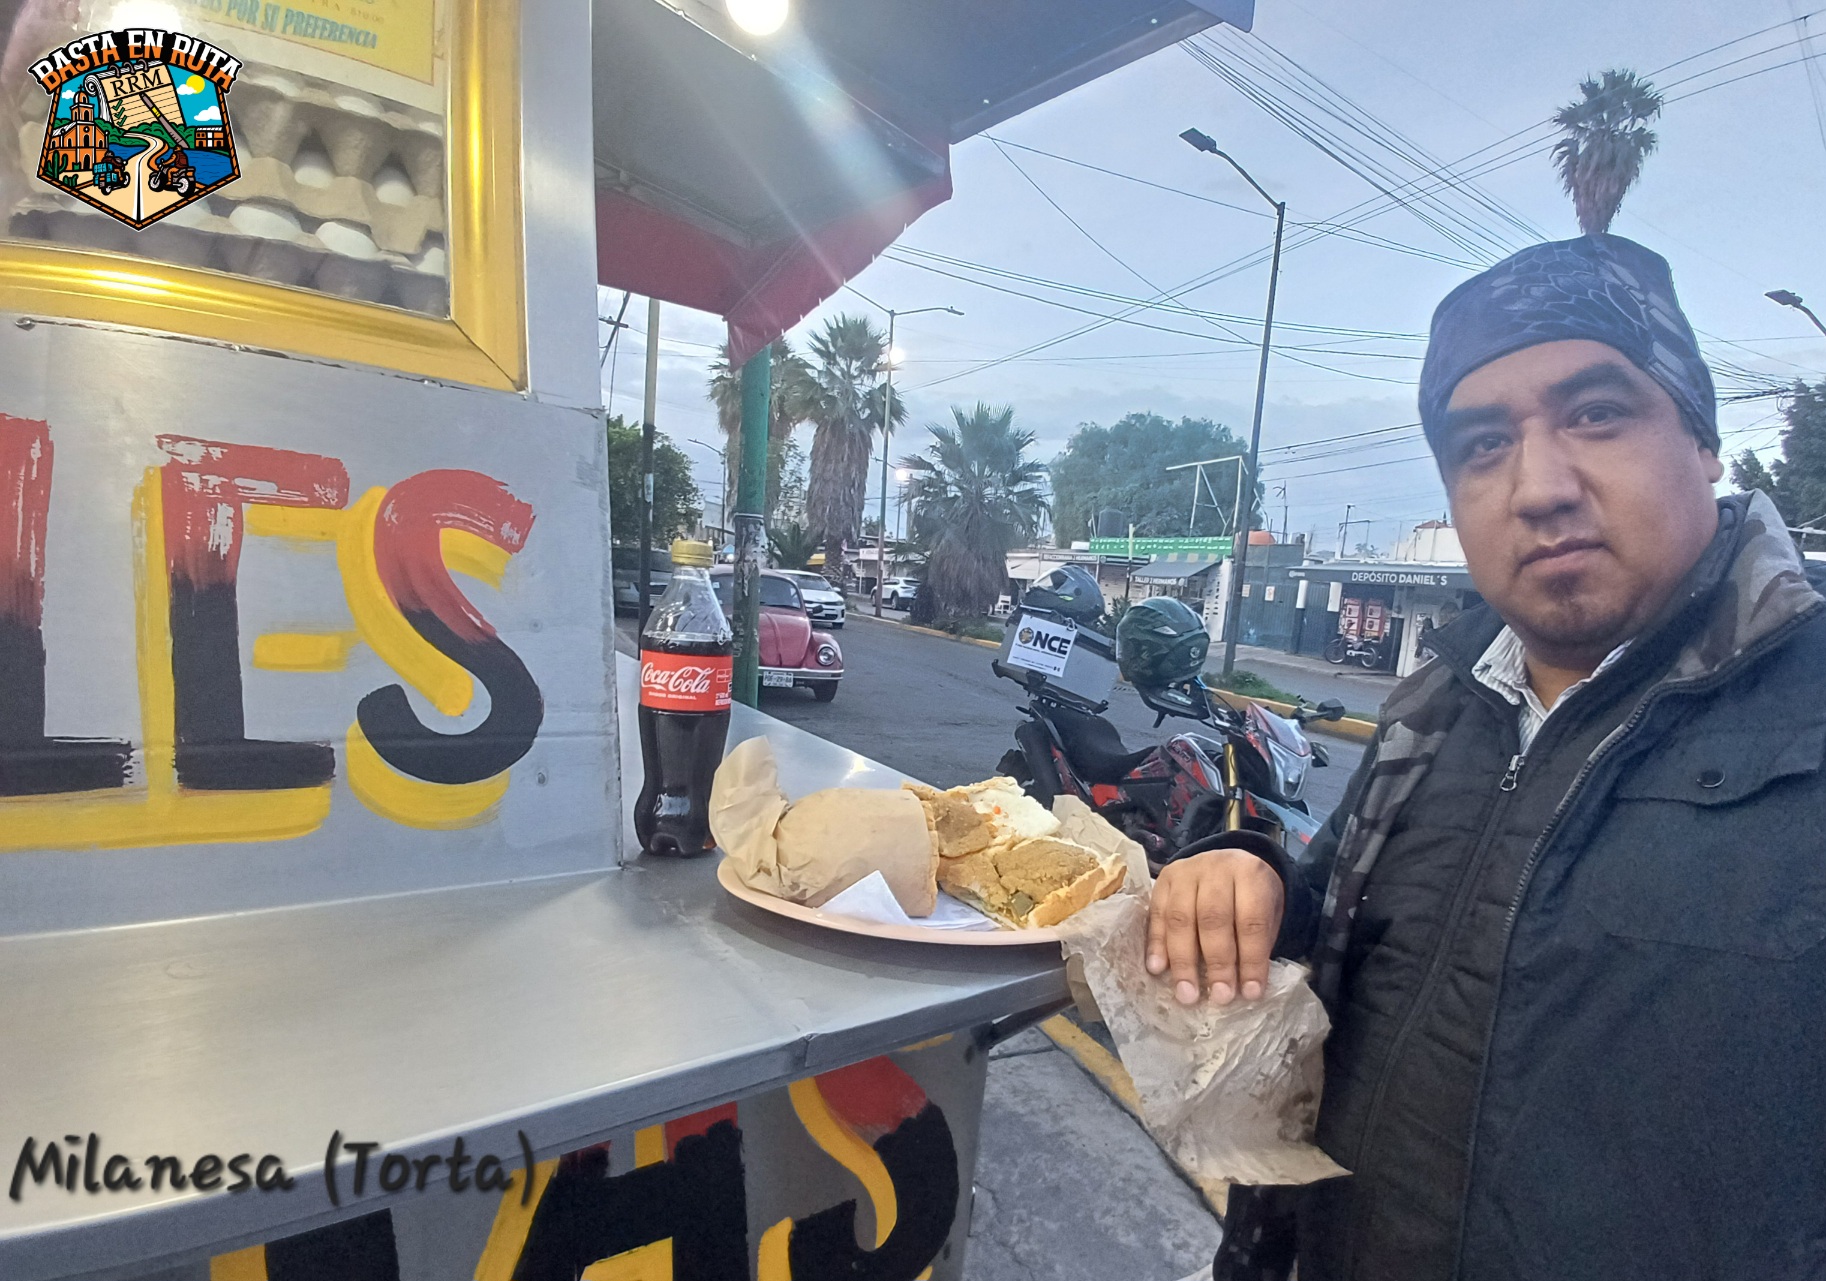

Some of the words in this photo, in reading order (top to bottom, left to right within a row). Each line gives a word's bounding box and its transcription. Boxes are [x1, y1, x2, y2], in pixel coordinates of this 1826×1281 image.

[282, 8, 378, 49] PREFERENCIA
[1351, 571, 1398, 583] DEPÓSITO
[641, 662, 716, 693] Coca-Cola
